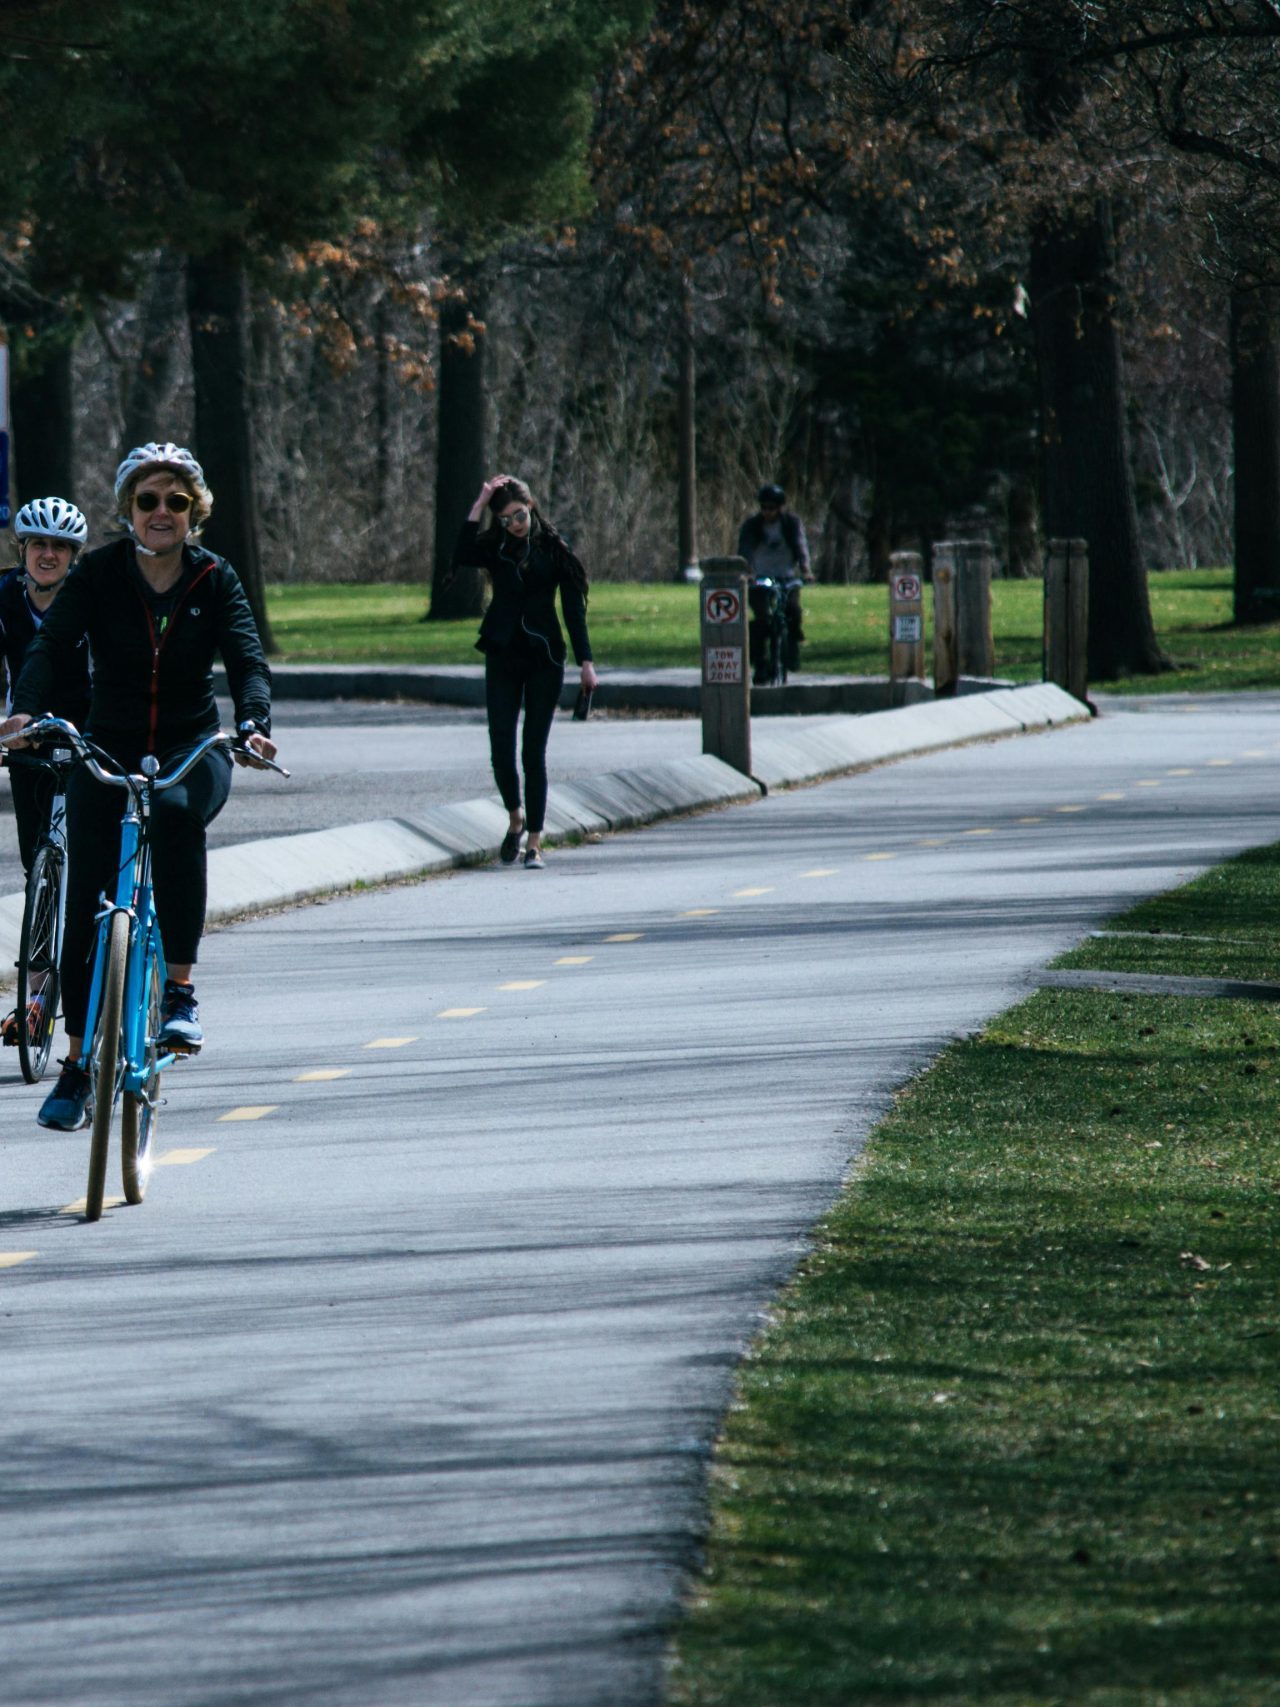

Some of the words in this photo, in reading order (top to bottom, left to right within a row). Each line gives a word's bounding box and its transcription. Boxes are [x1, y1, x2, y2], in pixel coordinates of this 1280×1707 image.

[715, 651, 734, 659] TOW
[711, 662, 738, 670] AWAY
[711, 672, 738, 680] ZONE
